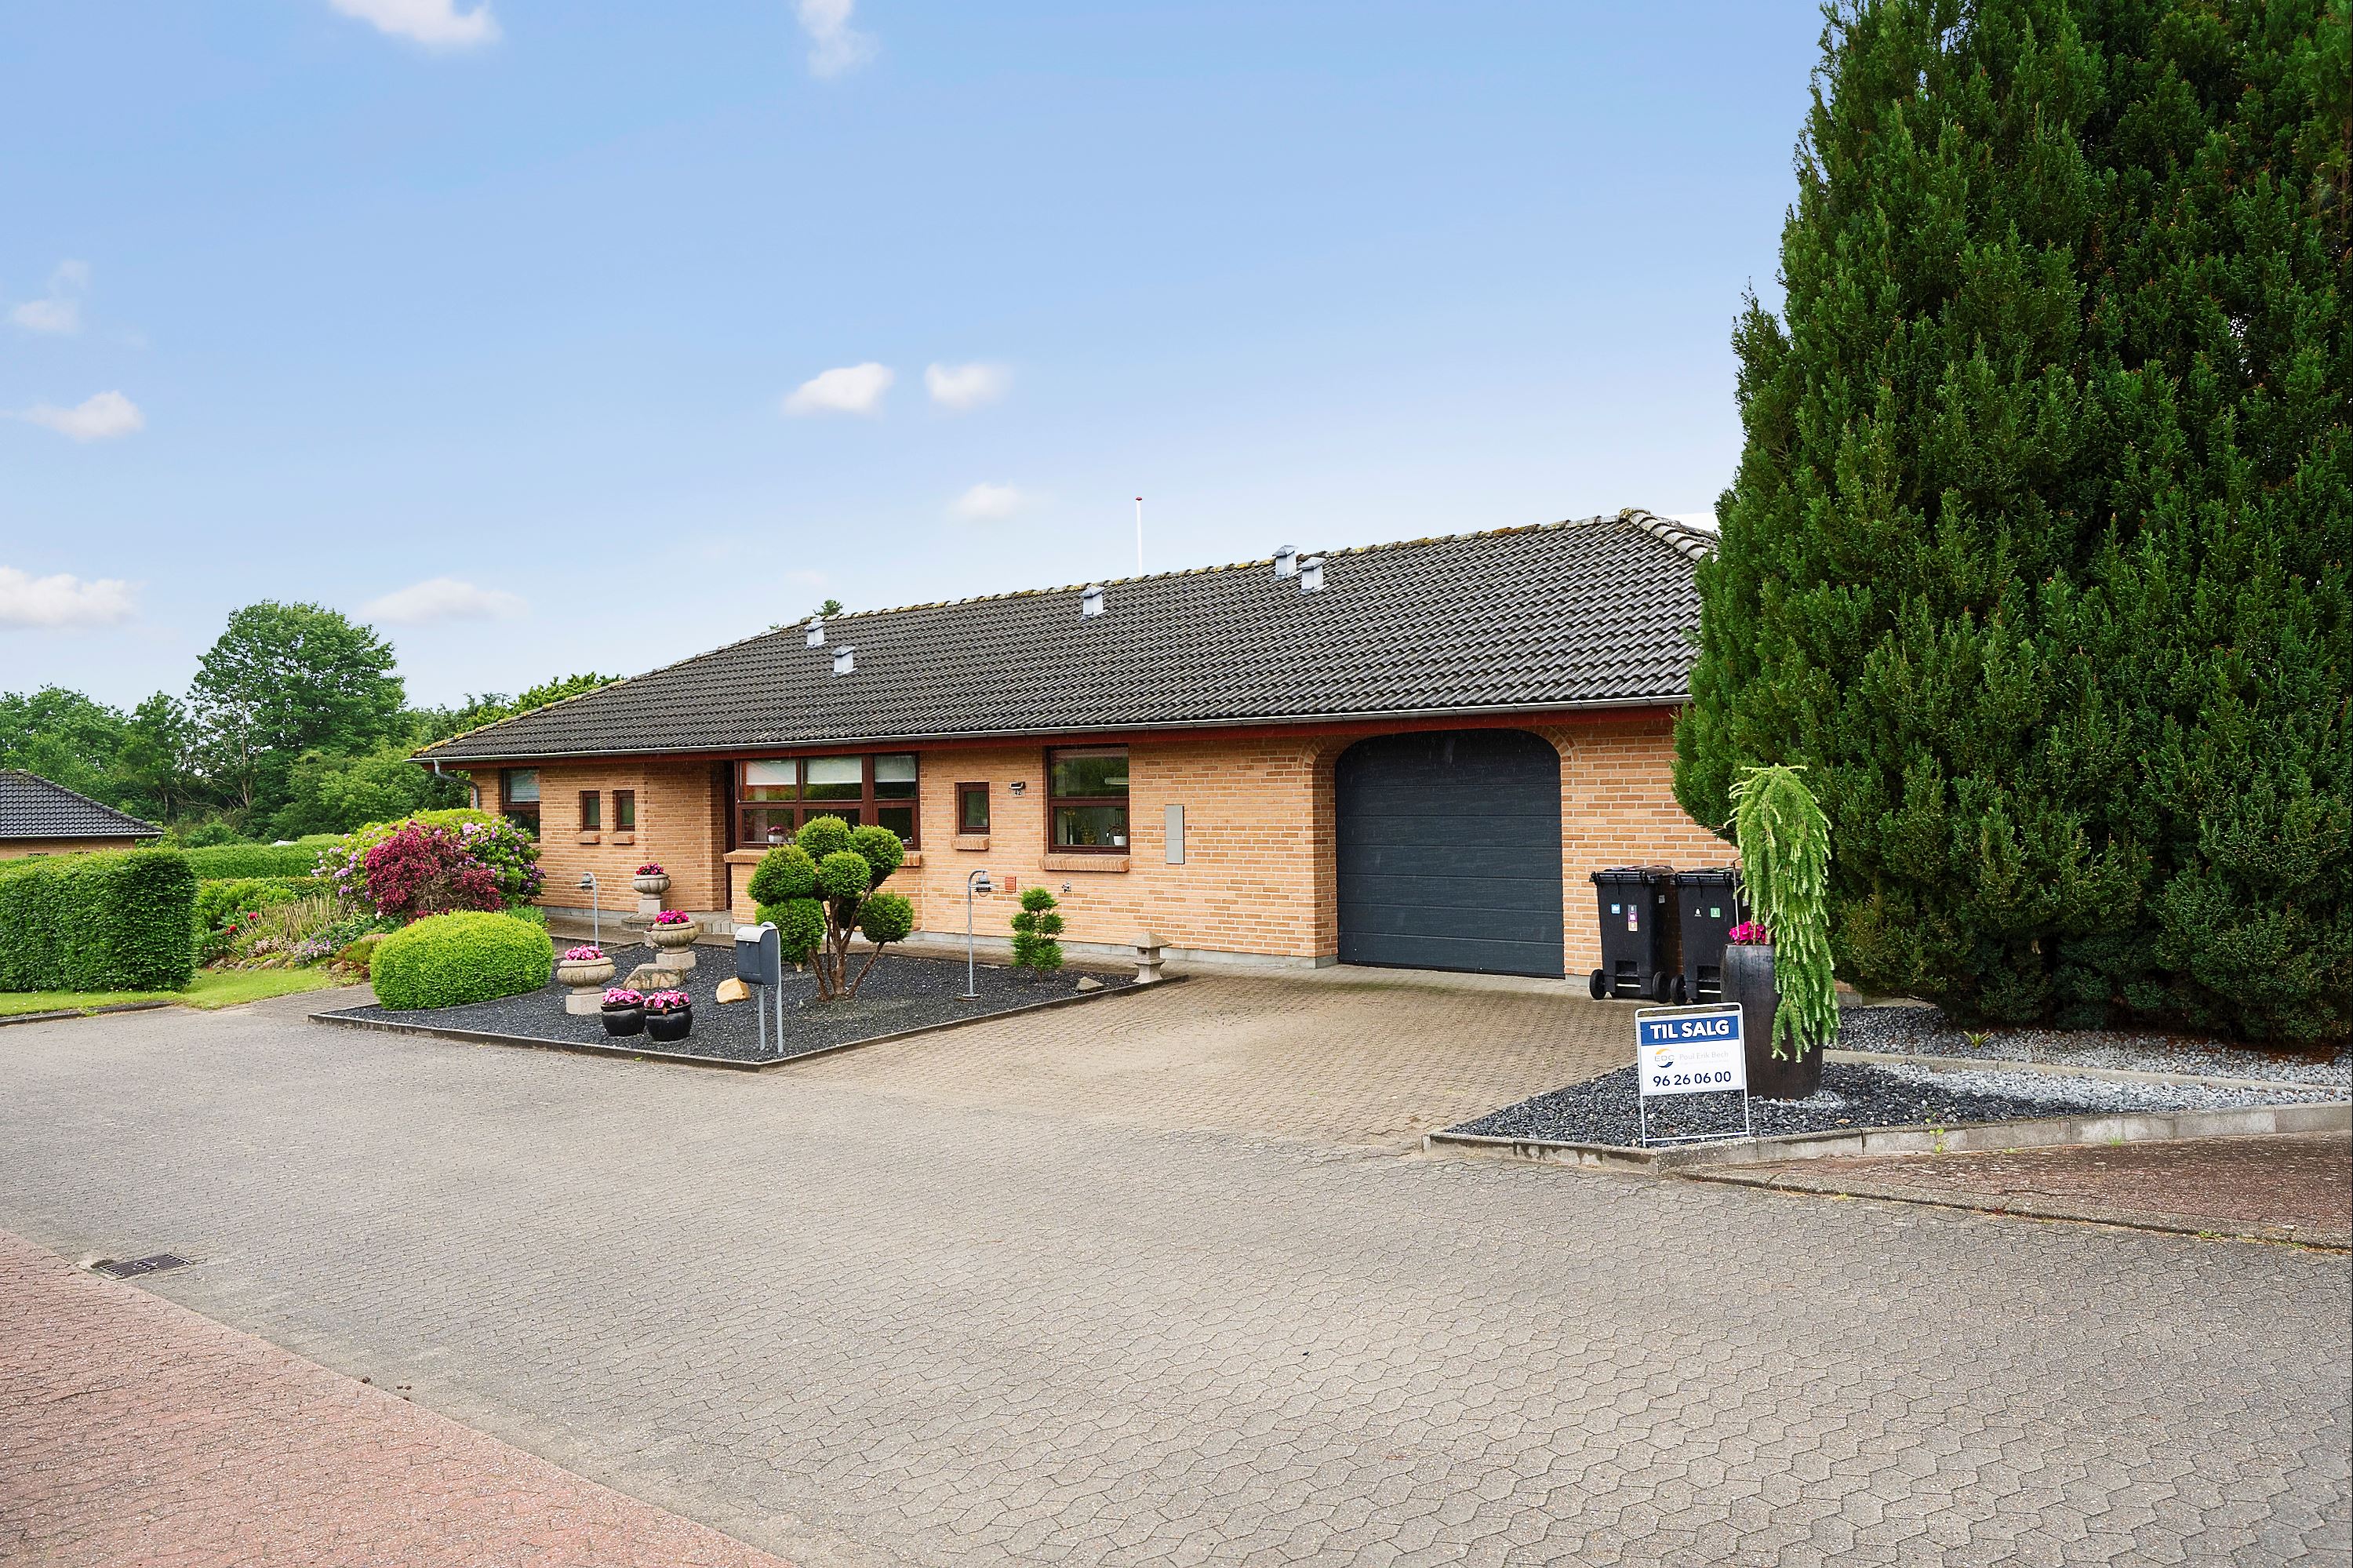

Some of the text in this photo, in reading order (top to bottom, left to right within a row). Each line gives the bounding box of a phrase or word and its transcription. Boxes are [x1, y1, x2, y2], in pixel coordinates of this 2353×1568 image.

[1650, 1020, 1729, 1039] TIL SALG
[1653, 1071, 1732, 1087] 96 26 06 00
